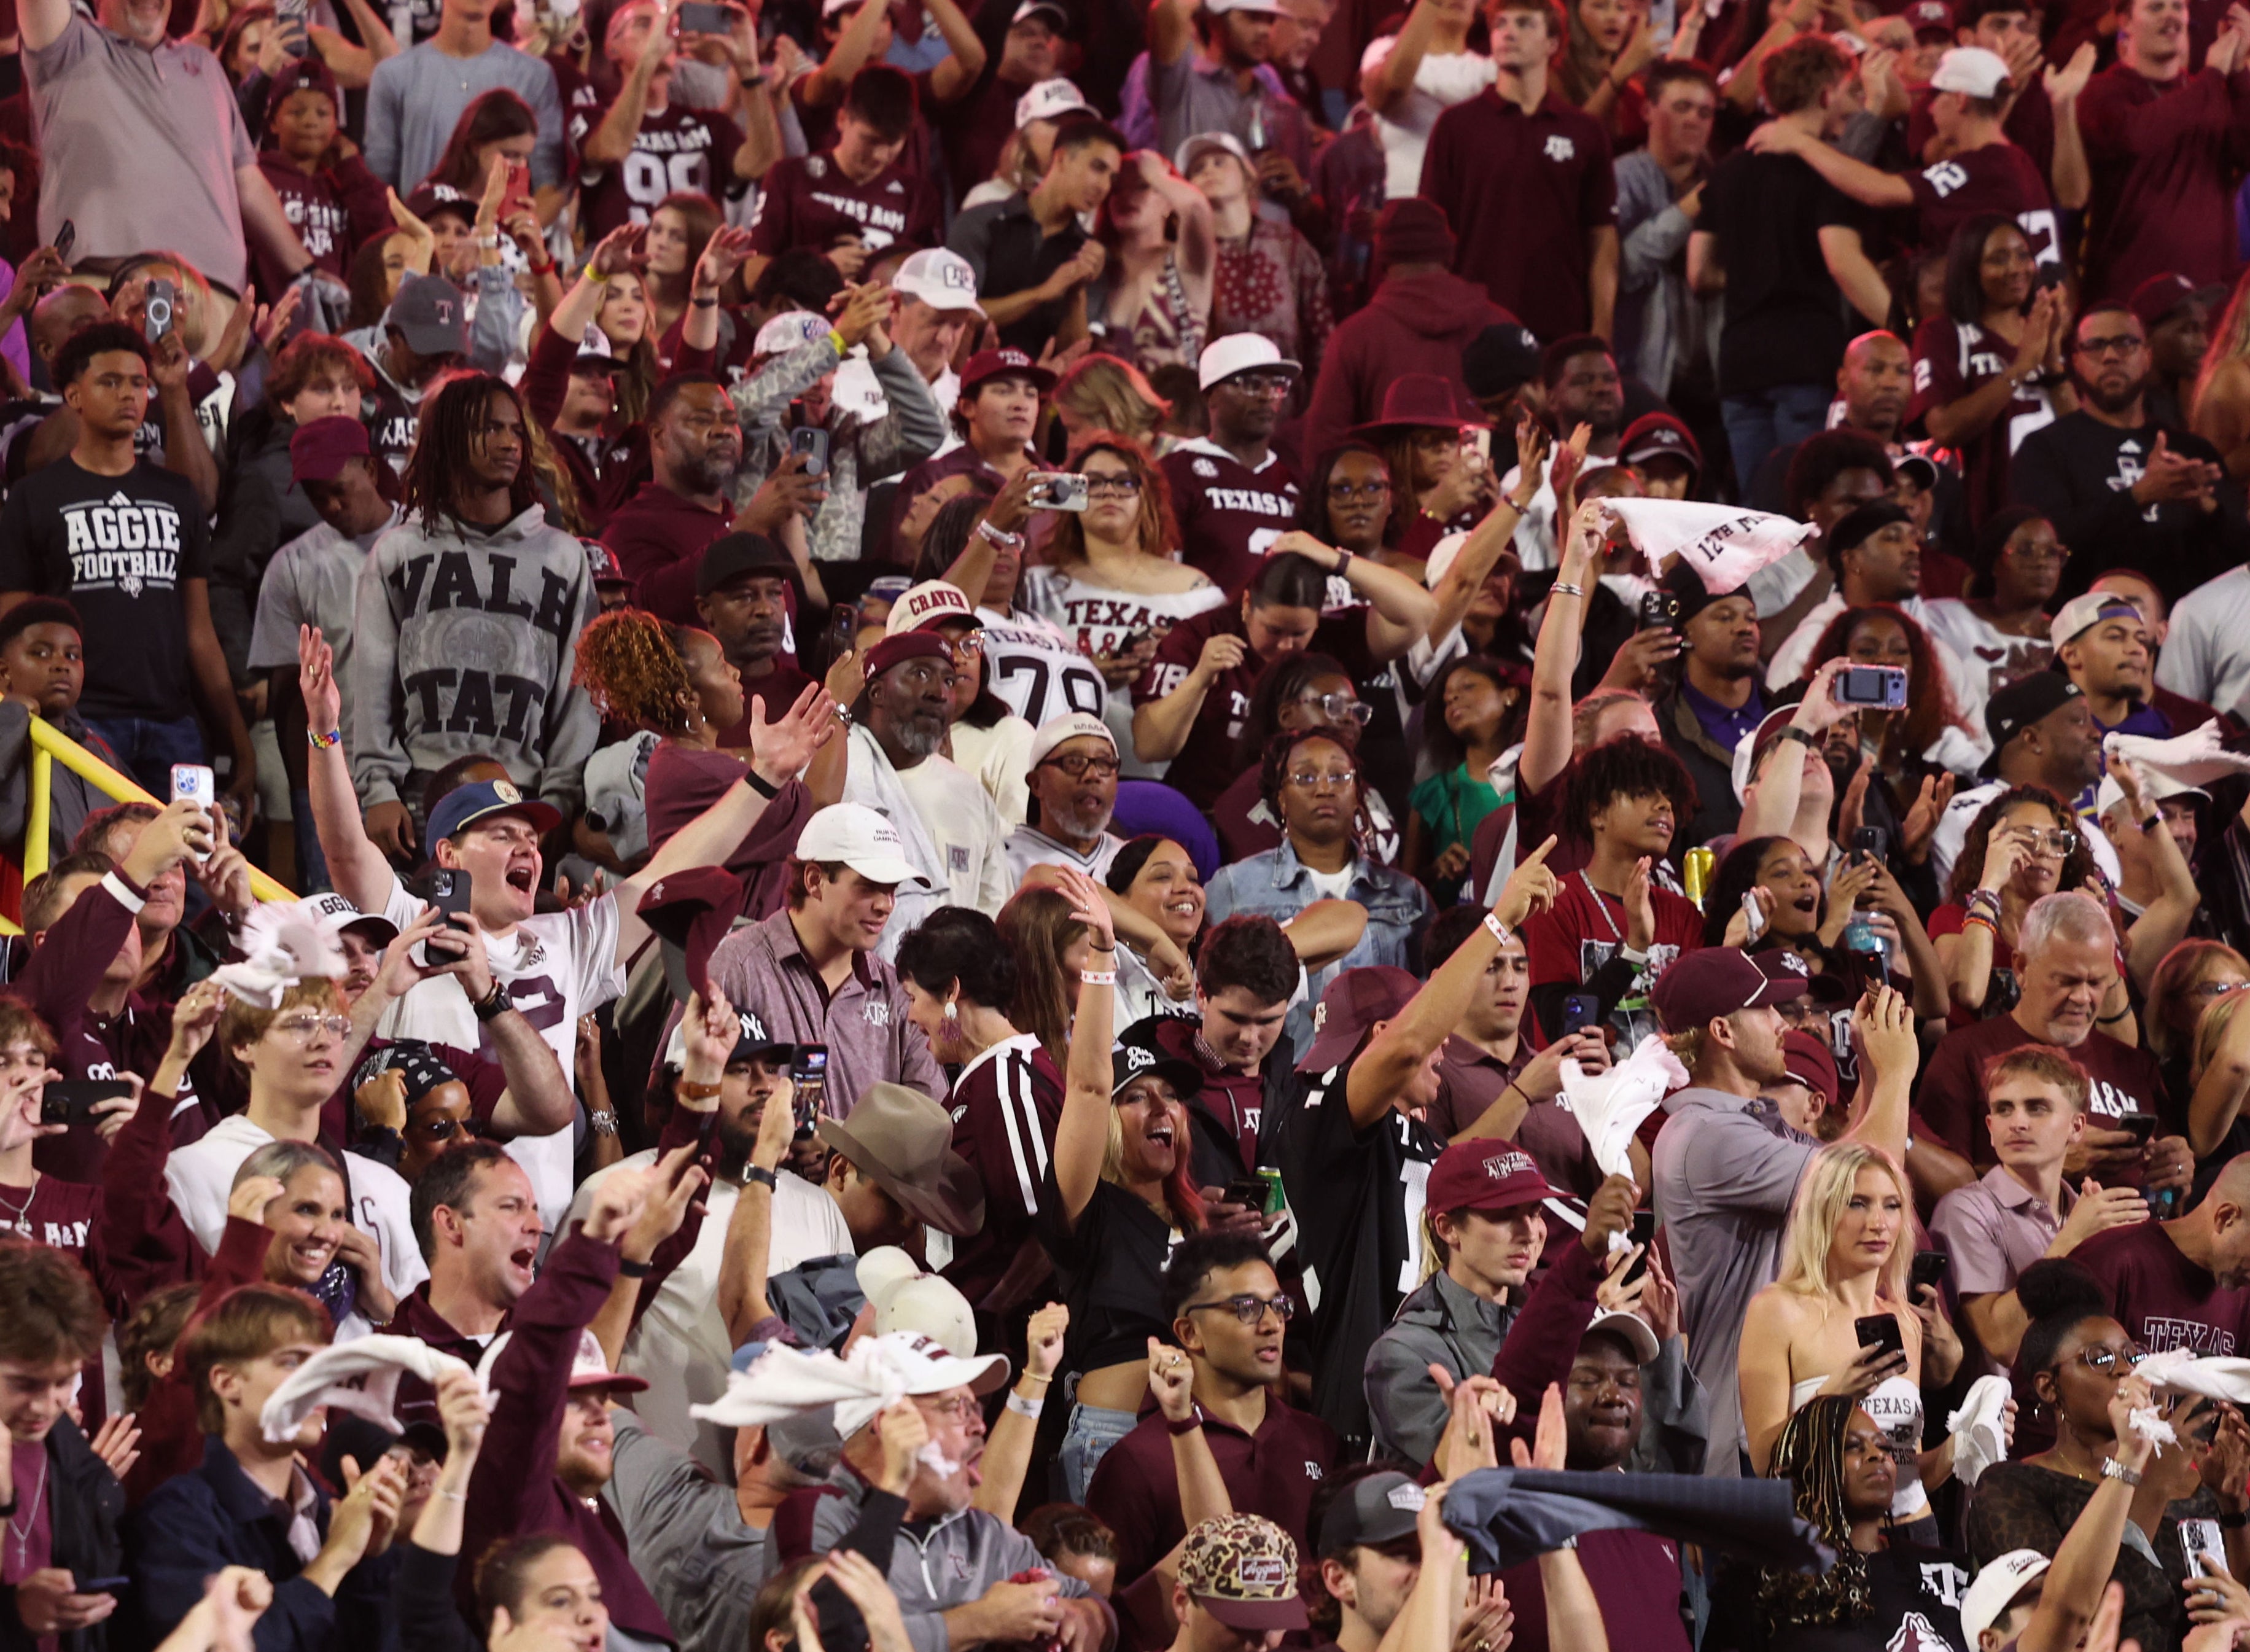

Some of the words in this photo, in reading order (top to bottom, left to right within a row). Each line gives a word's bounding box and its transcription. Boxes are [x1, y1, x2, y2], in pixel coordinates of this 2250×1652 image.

[1204, 486, 1279, 516] TEXAS
[64, 507, 181, 555] AGGIE
[71, 550, 177, 583] FOOTBALL
[739, 1011, 768, 1041] NY
[2089, 1076, 2138, 1120] A&M
[1863, 1397, 1912, 1415] TEXAS
